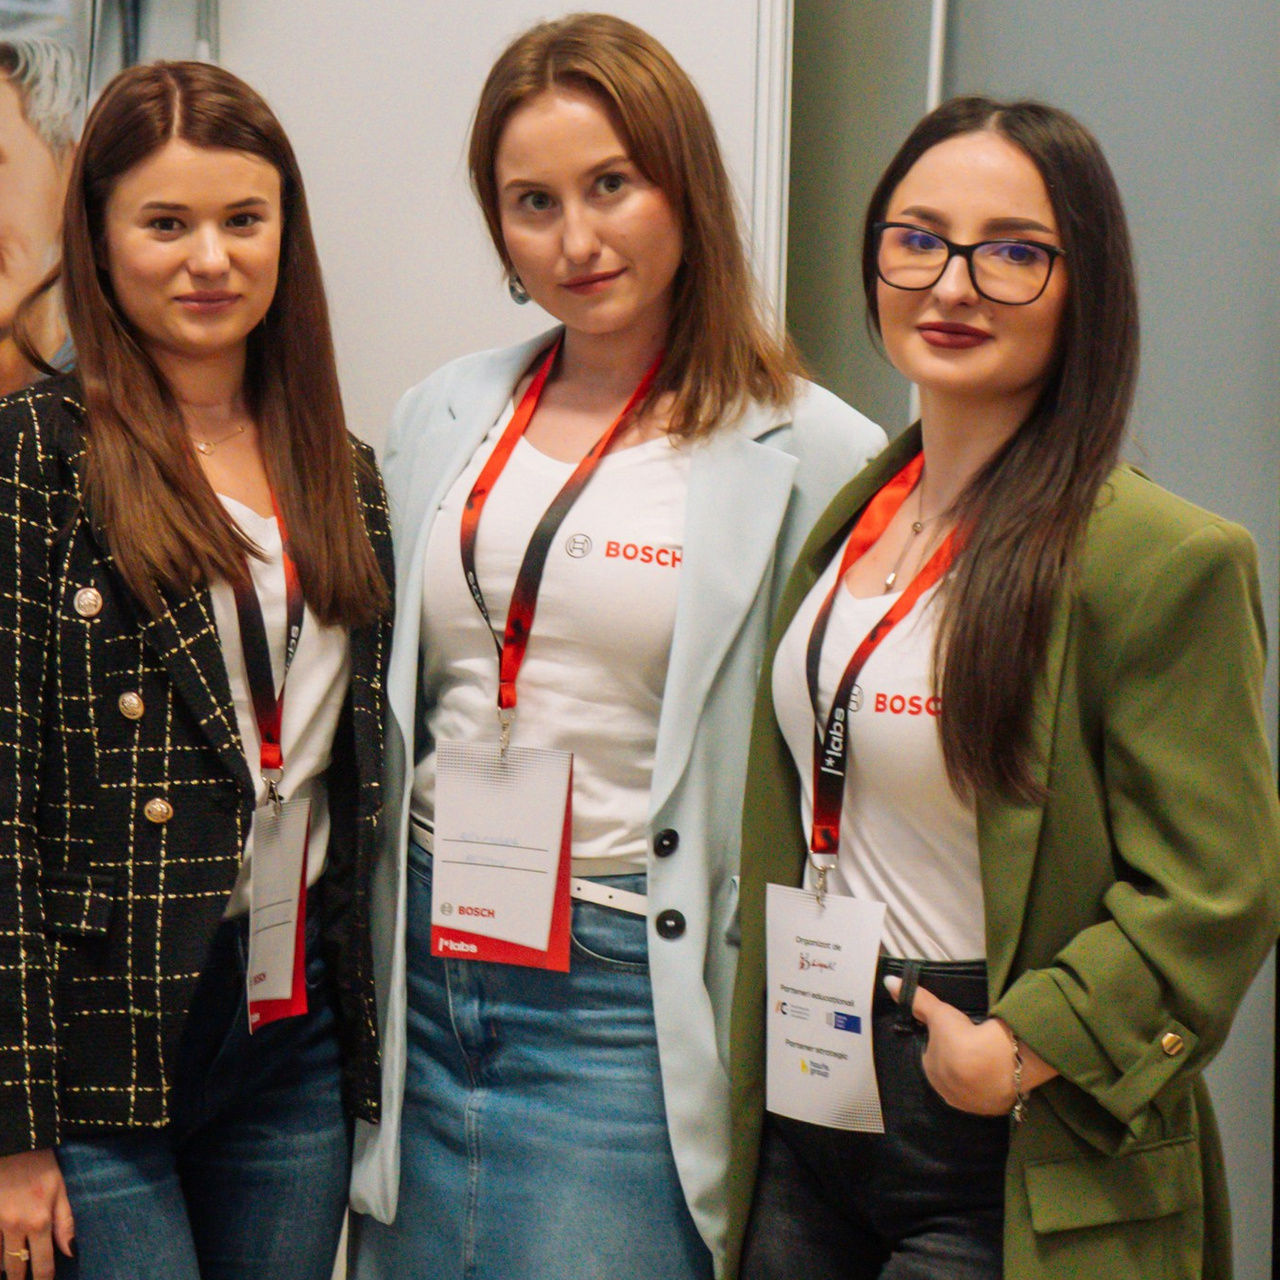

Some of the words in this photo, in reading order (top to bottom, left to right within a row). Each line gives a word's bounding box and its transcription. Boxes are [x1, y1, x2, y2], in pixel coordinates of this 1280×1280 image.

[605, 540, 682, 568] BOSCH
[874, 692, 942, 717] BOSC
[458, 905, 495, 918] BOSCH
